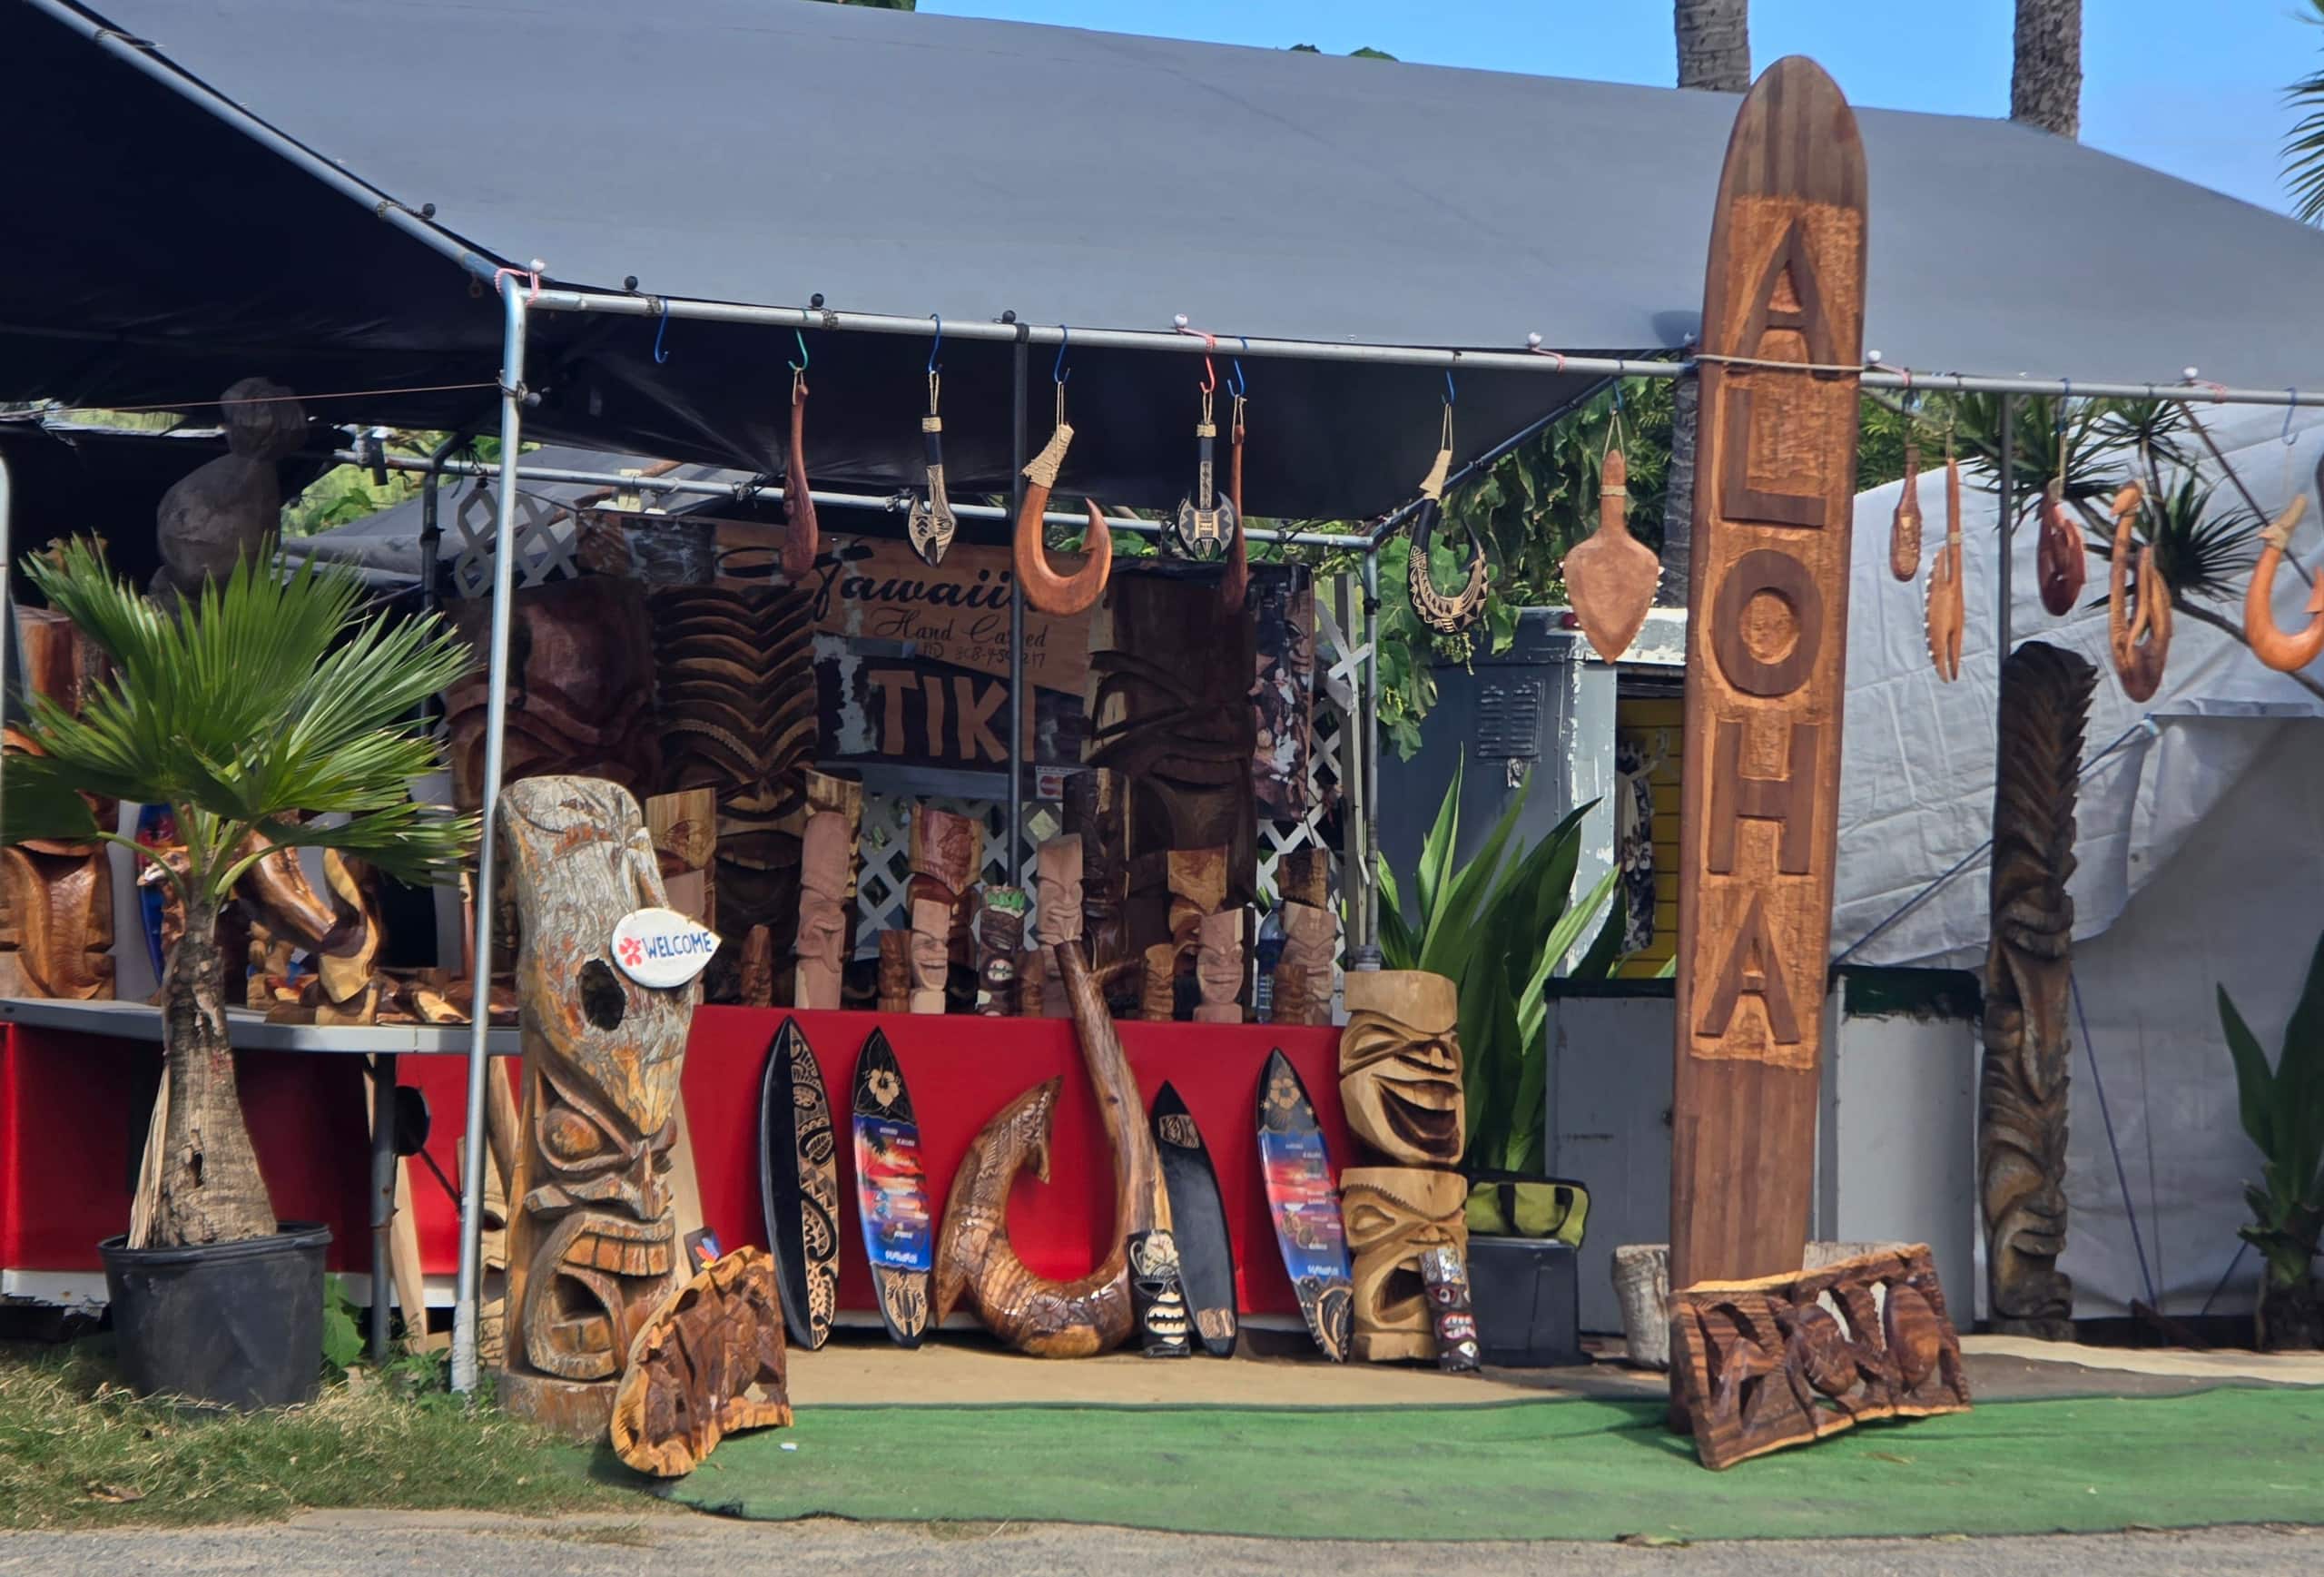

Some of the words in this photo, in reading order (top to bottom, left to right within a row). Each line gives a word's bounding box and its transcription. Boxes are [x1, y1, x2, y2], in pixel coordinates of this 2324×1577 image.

[870, 606, 954, 641] Hand
[962, 613, 1049, 648] Caed
[1694, 218, 1842, 1046] ALOHA
[641, 931, 713, 959] WELCOME
